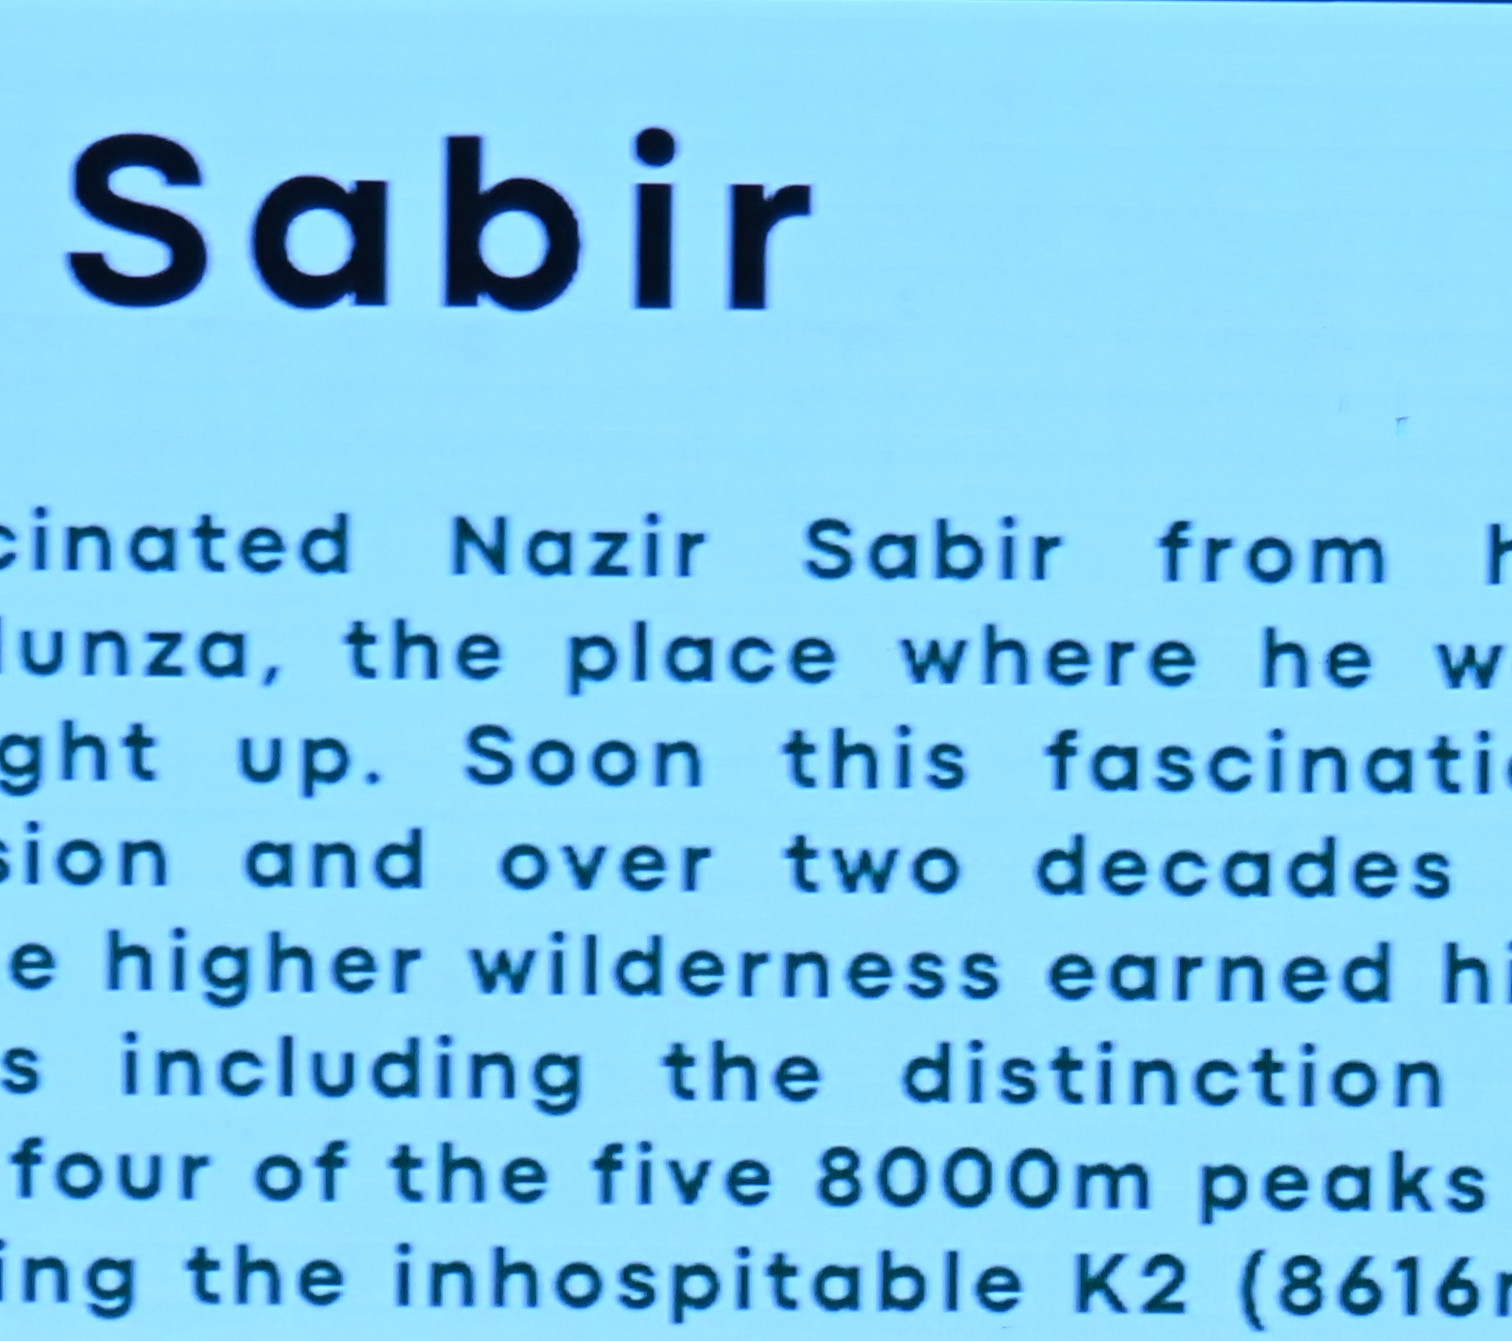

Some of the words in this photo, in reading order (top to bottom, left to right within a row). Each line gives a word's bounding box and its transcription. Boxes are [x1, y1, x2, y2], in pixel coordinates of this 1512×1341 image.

[63, 124, 814, 315] Sabir
[449, 510, 709, 581] Nazir
[802, 513, 1066, 584] Sabir
[1155, 518, 1389, 588] from
[341, 615, 505, 684] the
[565, 617, 839, 700] place
[897, 620, 1199, 691] where
[1259, 624, 1375, 692] he
[236, 735, 383, 802] up.
[462, 721, 705, 791] Soon
[779, 721, 970, 794] this
[242, 825, 425, 893] and
[497, 841, 715, 895] over
[781, 832, 963, 898] two
[1033, 831, 1453, 903] decades
[104, 924, 425, 1012] higher
[466, 928, 1003, 1003] wilderness
[1045, 938, 1394, 1007] earned
[120, 1028, 585, 1119] including
[658, 1037, 824, 1106] the
[899, 1037, 1445, 1111] distinction
[7, 1134, 213, 1204] four
[251, 1137, 351, 1205] of
[385, 1139, 551, 1207] the
[589, 1138, 774, 1210] five
[814, 1143, 1153, 1213] 8000m
[1198, 1147, 1488, 1228] peaks
[182, 1241, 347, 1309] the
[393, 1240, 1025, 1327] inhospitable
[1073, 1250, 1189, 1317] K2
